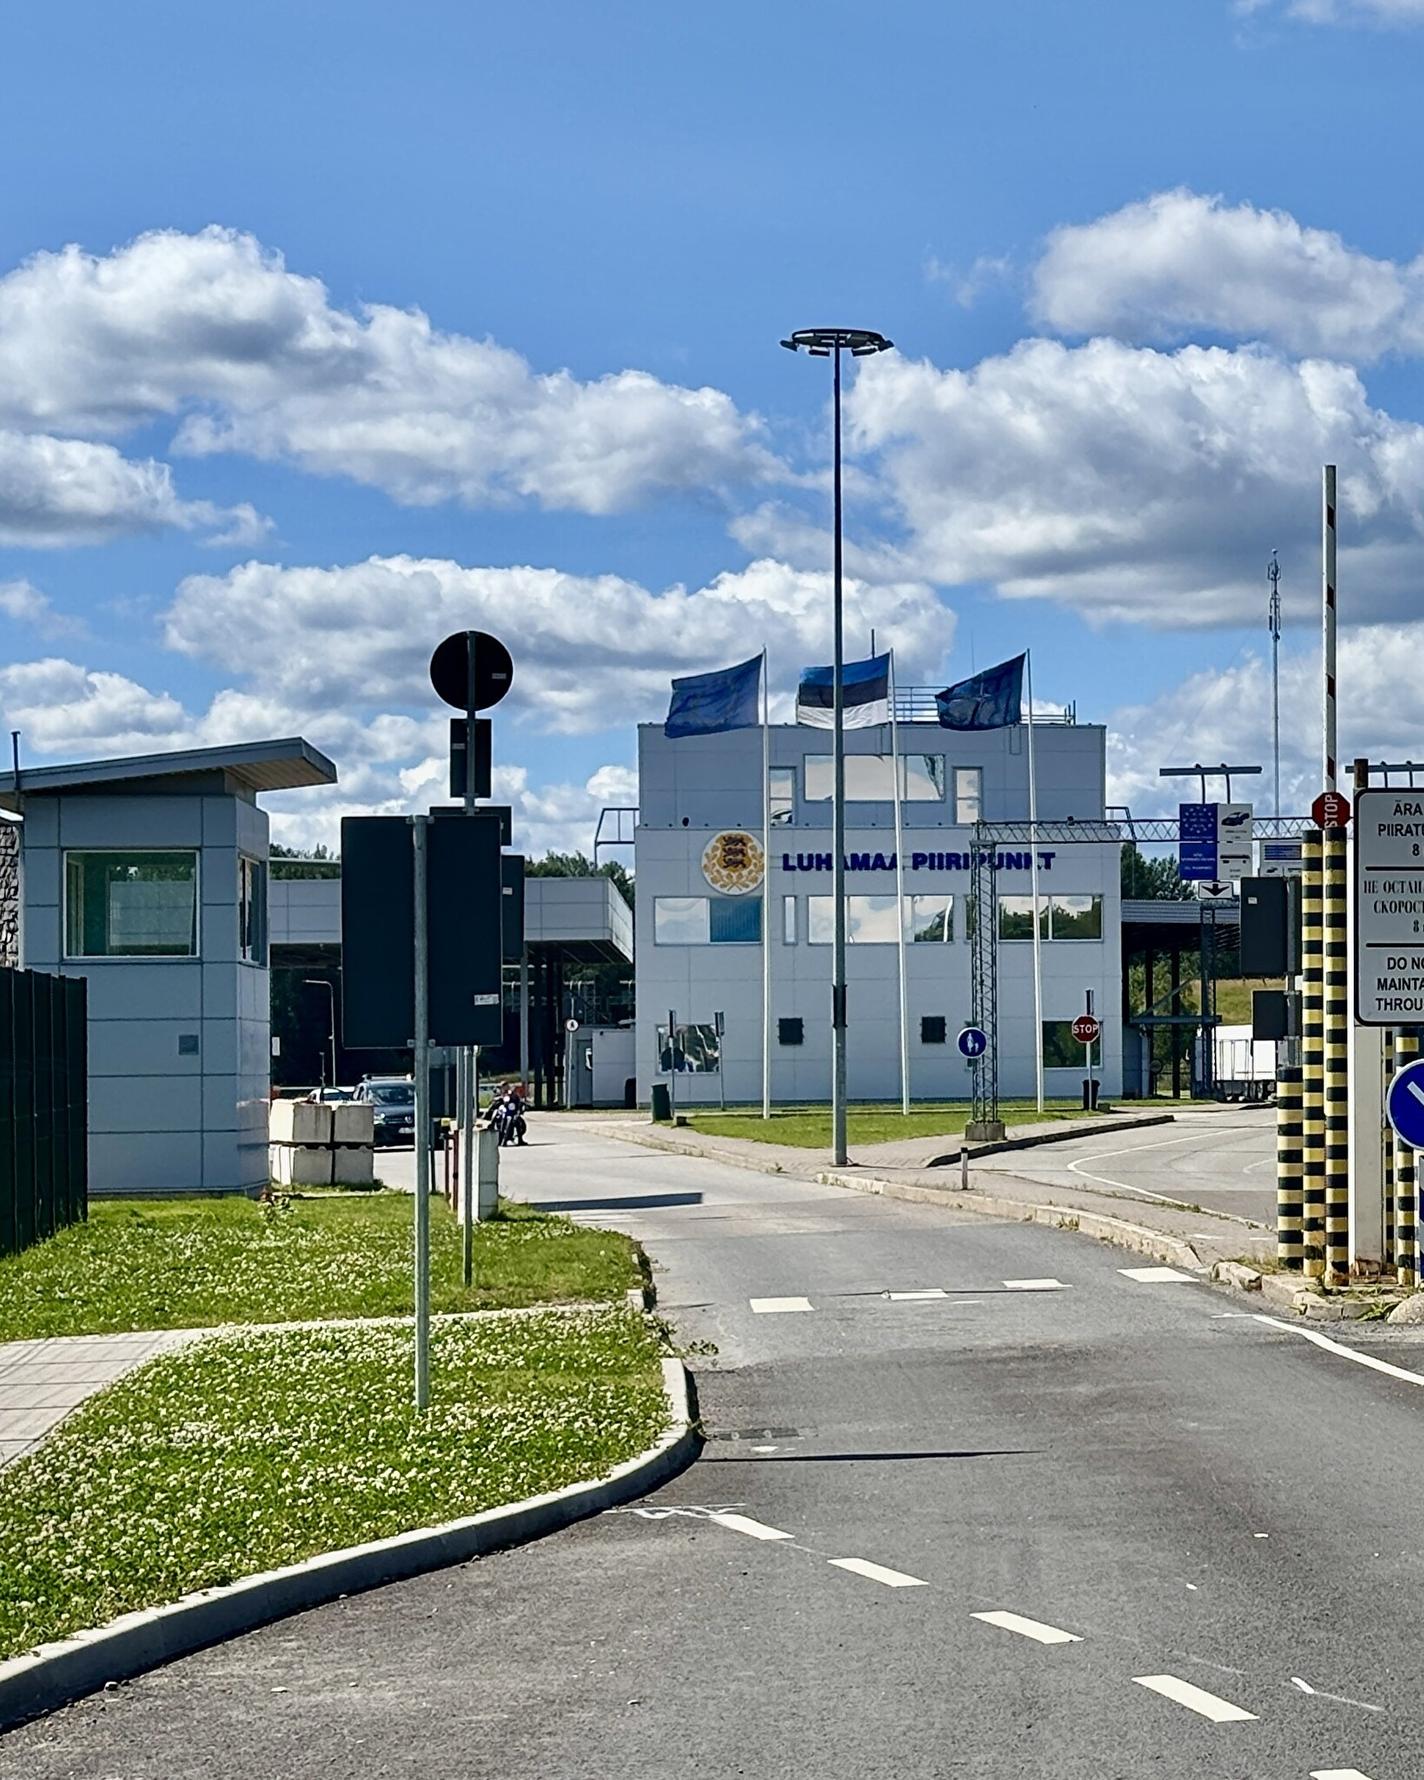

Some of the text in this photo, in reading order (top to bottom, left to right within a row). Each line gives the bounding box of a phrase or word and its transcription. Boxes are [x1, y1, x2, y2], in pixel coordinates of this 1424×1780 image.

[1324, 794, 1338, 829] STOP
[1393, 800, 1423, 817] ÄRA
[1412, 843, 1420, 857] 8
[1364, 880, 1379, 895] НЕ
[1413, 920, 1420, 933] 8
[1387, 957, 1408, 971] DO
[1073, 1024, 1100, 1035] STOP
